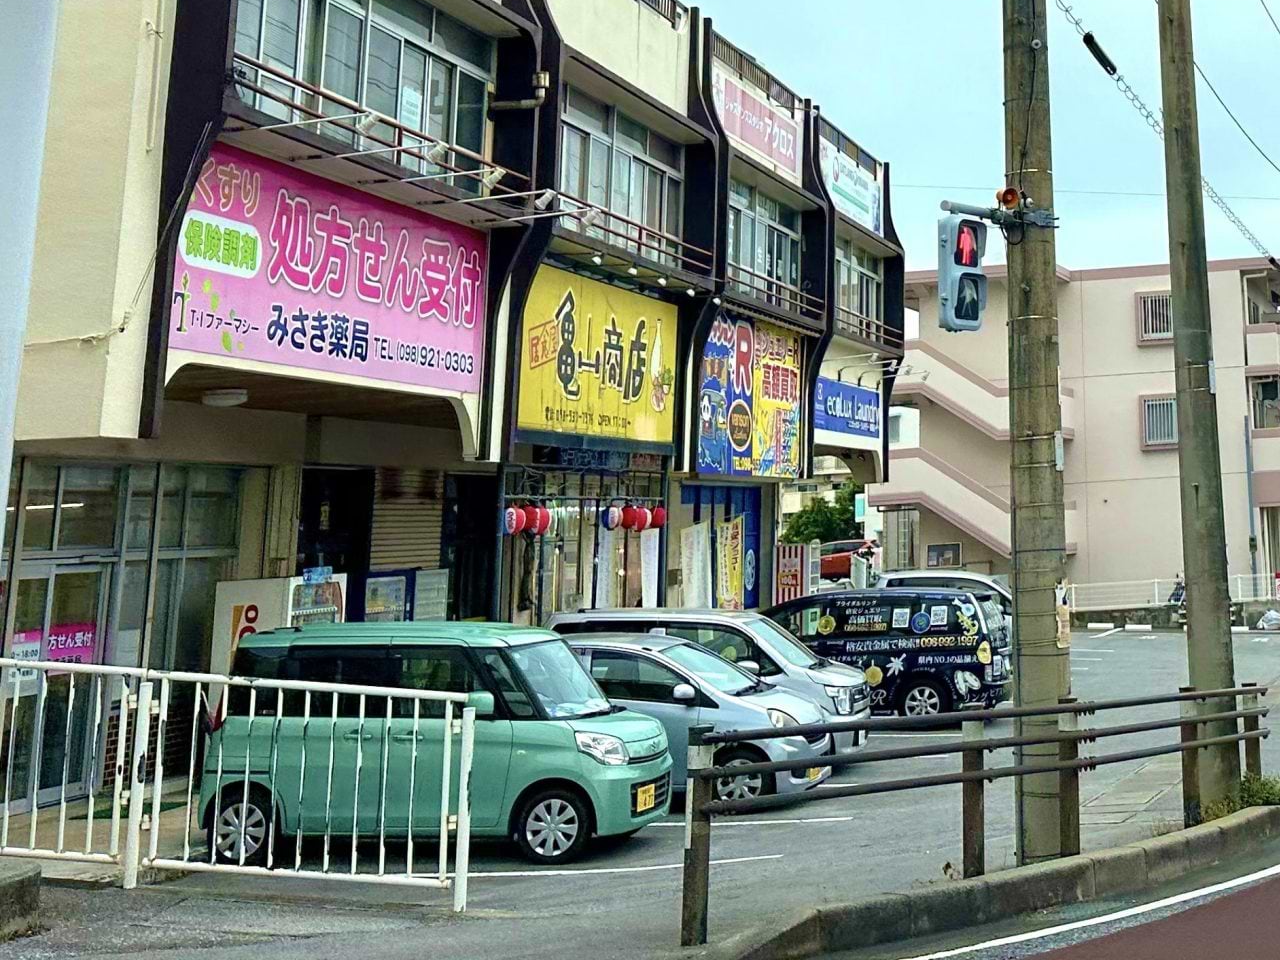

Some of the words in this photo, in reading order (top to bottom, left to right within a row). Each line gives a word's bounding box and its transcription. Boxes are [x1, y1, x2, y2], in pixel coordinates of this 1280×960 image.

[764, 116, 794, 160] アクロス
[196, 157, 261, 218] くすり
[184, 218, 258, 271] 保険調剤
[267, 188, 482, 329] 処方せん受付
[267, 304, 370, 362] みさき薬局
[374, 337, 394, 361] TEL
[396, 343, 474, 375] (098)921-0303
[734, 322, 753, 395] R
